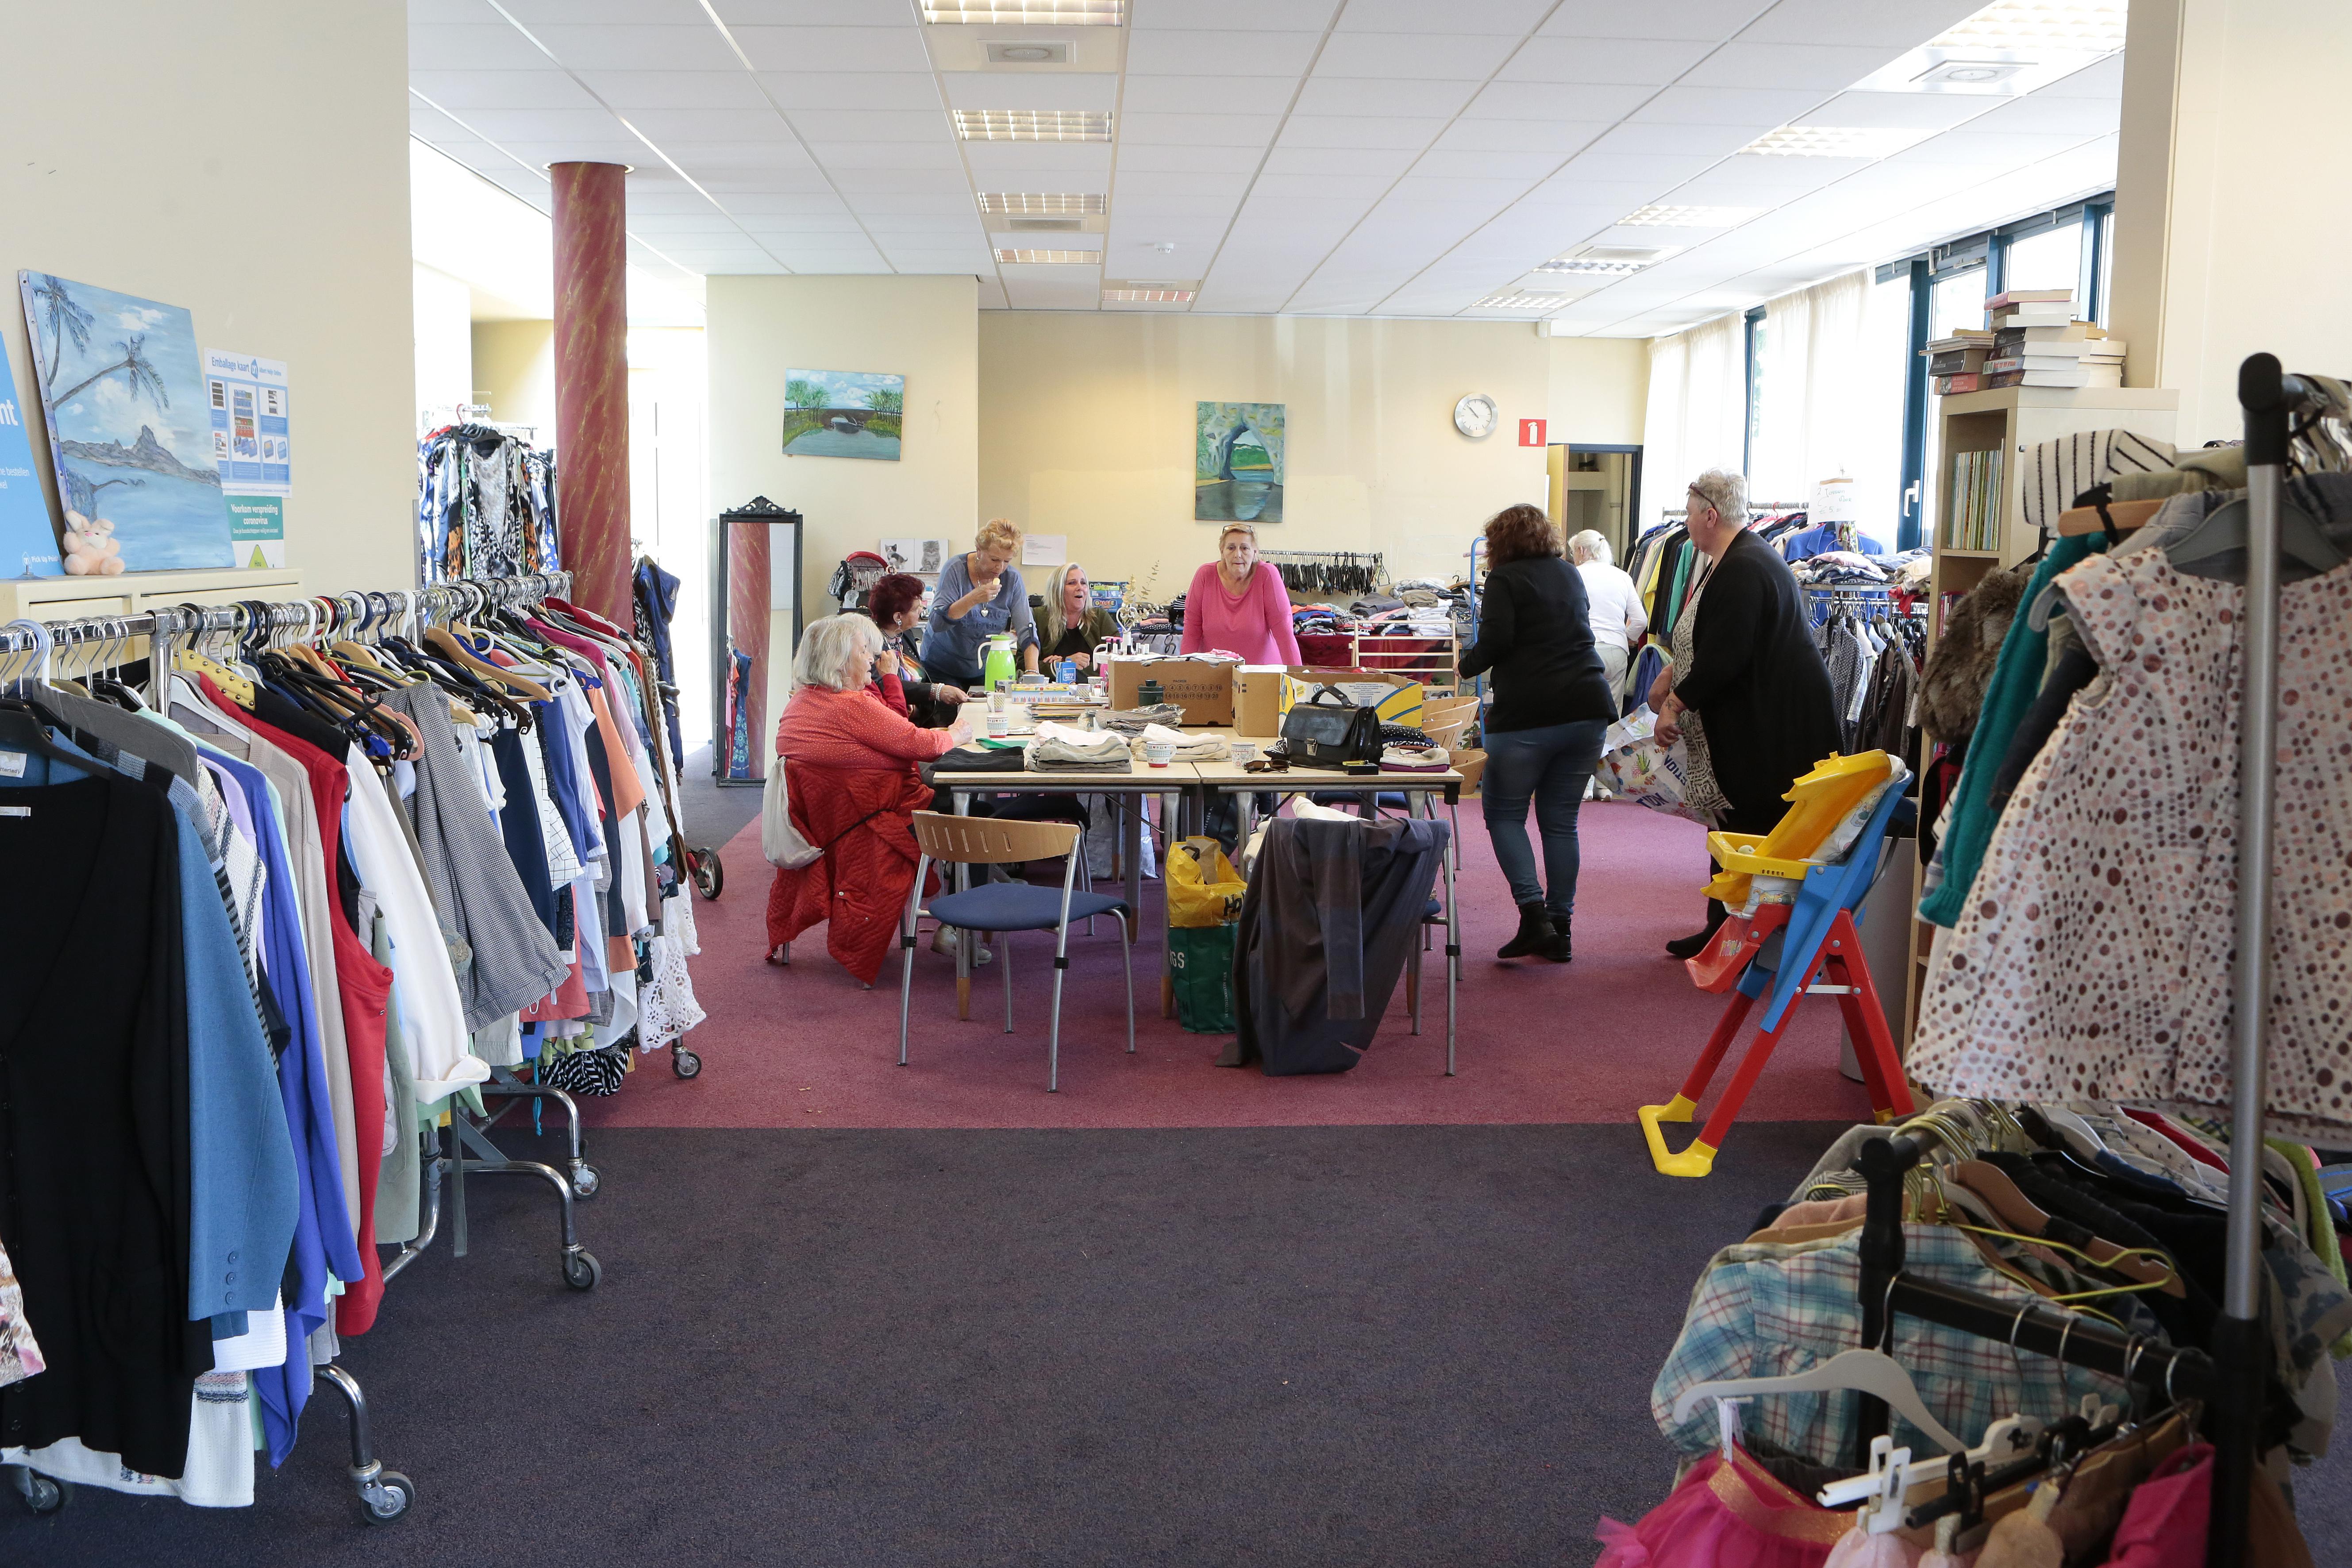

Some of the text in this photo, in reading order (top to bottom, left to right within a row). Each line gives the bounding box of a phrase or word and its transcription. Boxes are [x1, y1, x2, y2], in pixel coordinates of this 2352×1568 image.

[212, 357, 236, 372] Emballage
[237, 361, 250, 372] kaart
[5, 466, 30, 476] bestellen
[231, 504, 278, 516] Voorkom verspreiding
[243, 516, 268, 525] coronavirus
[964, 609, 1010, 619] VINAGE
